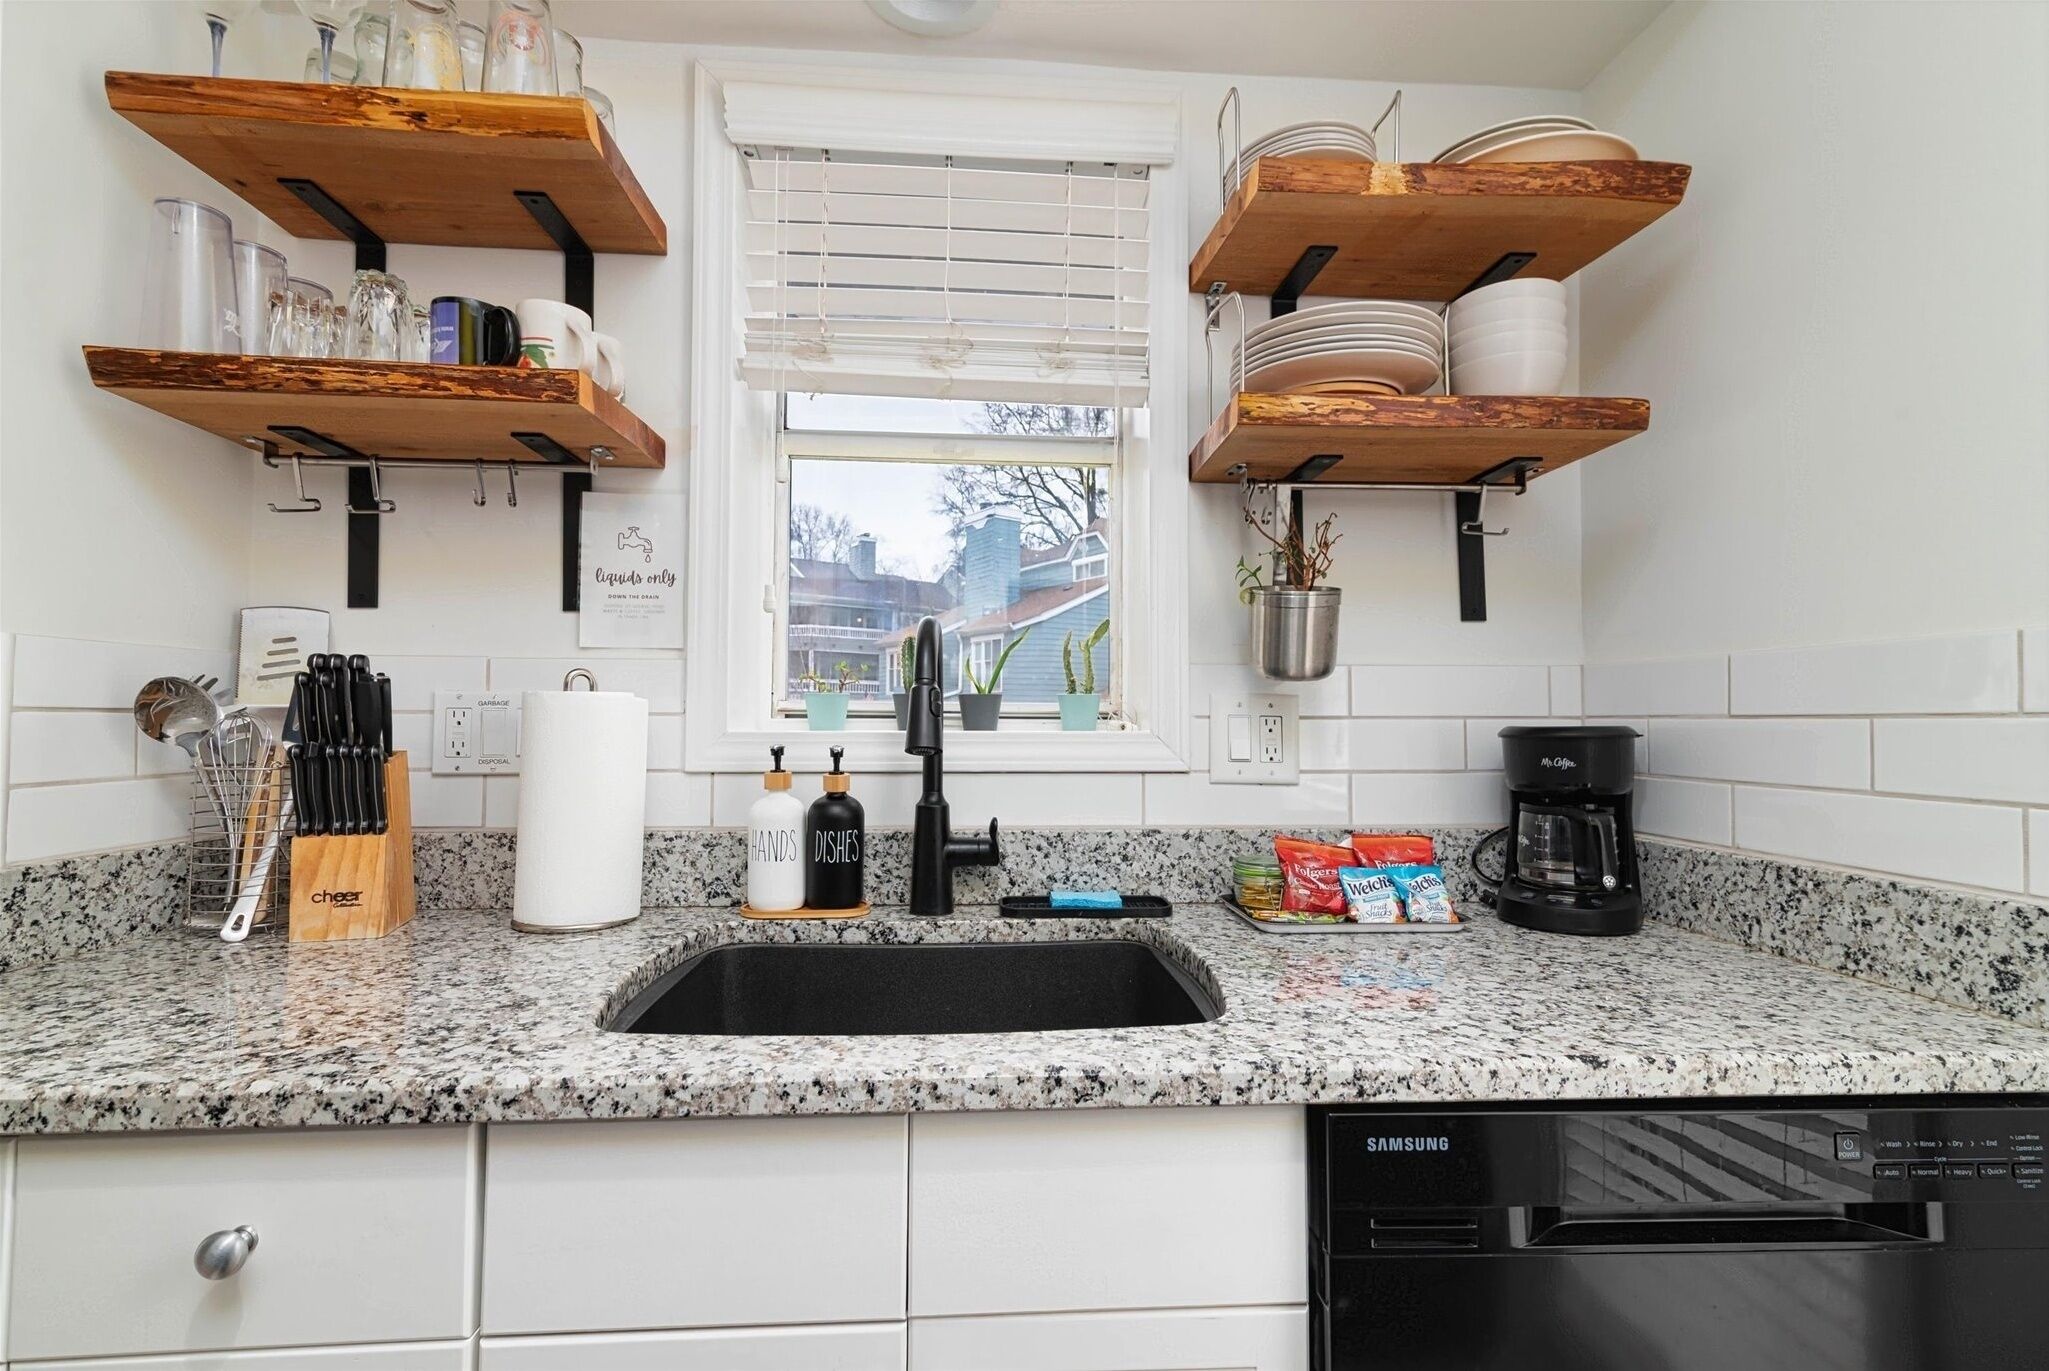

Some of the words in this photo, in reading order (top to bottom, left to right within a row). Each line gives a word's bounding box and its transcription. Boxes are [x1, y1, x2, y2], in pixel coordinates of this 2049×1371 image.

[596, 568, 642, 587] liquids
[647, 569, 676, 587] only
[1554, 757, 1576, 770] Coffee
[751, 829, 797, 862] HANDS
[815, 829, 859, 863] DISHES
[1294, 863, 1337, 879] Folgers
[1348, 876, 1394, 896] Welch's
[1409, 876, 1441, 892] elch's
[311, 889, 363, 904] cheer
[1367, 1137, 1448, 1152] SAMSUNG
